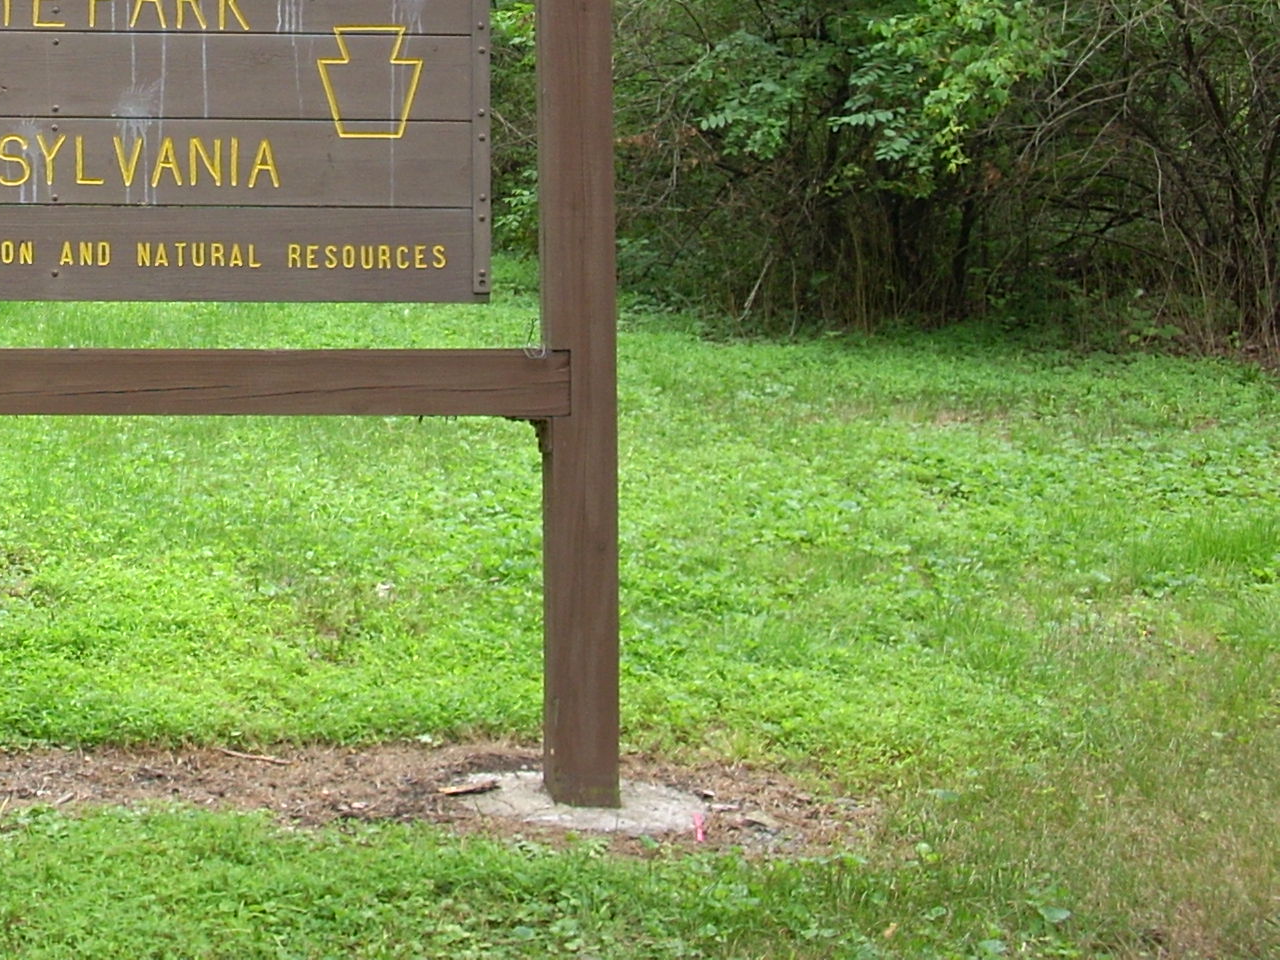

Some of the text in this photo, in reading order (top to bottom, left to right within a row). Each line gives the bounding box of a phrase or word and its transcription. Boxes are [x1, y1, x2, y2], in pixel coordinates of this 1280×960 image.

[59, 241, 111, 266] AND
[137, 242, 263, 268] NATURAL
[287, 243, 448, 270] RESOURCES
